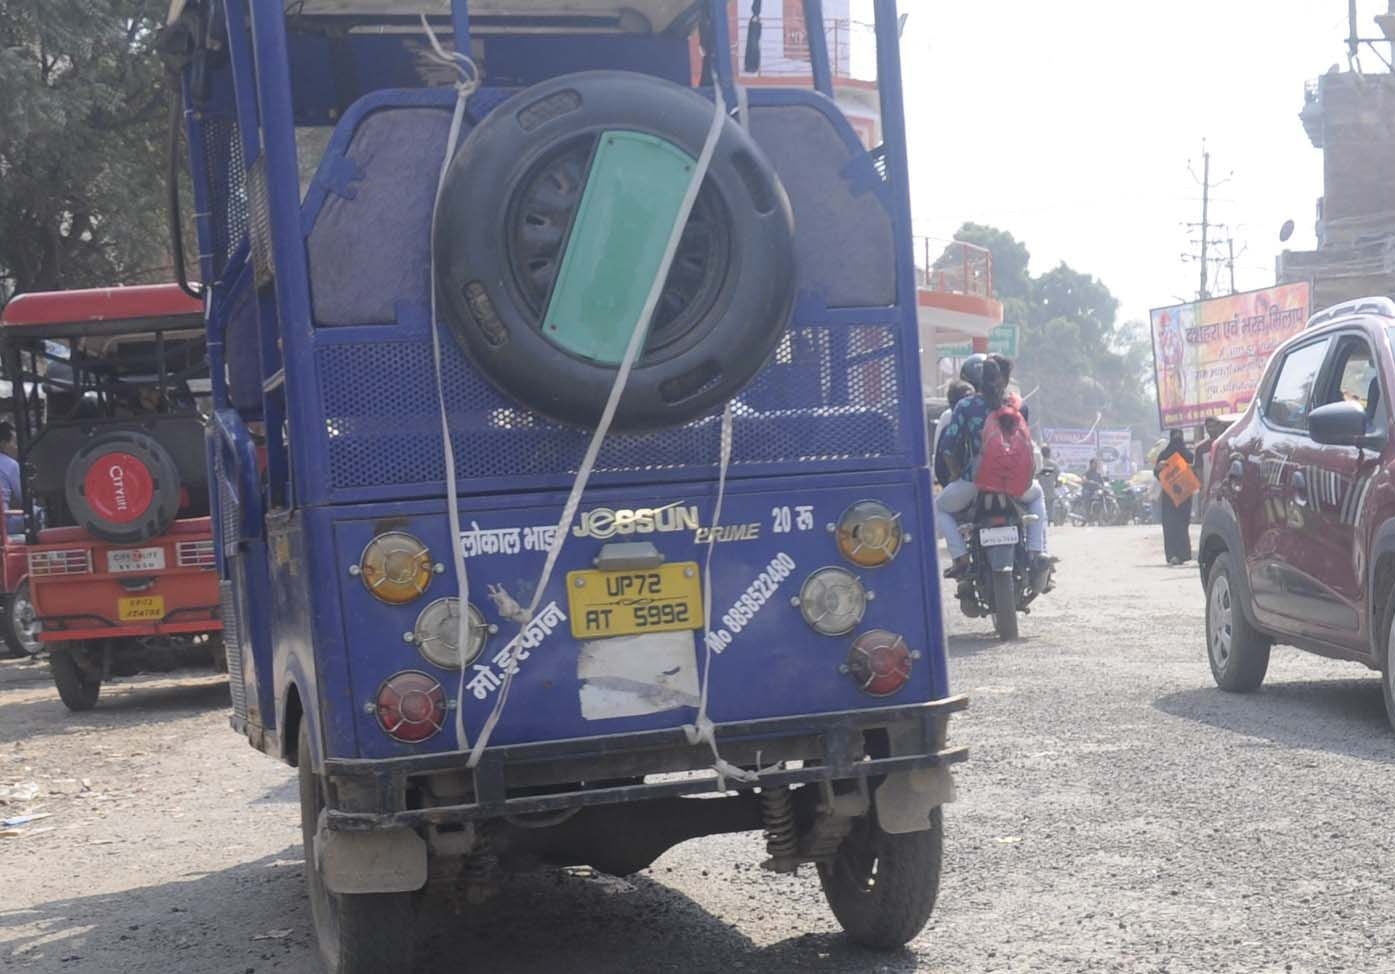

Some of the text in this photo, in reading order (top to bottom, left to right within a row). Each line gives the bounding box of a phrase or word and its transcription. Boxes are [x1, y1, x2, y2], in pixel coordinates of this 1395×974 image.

[772, 506, 792, 533] 20
[460, 520, 521, 558] लोकाल
[606, 573, 662, 597] UP72
[722, 552, 796, 632] 8858522480
[586, 602, 689, 630] AT 5992
